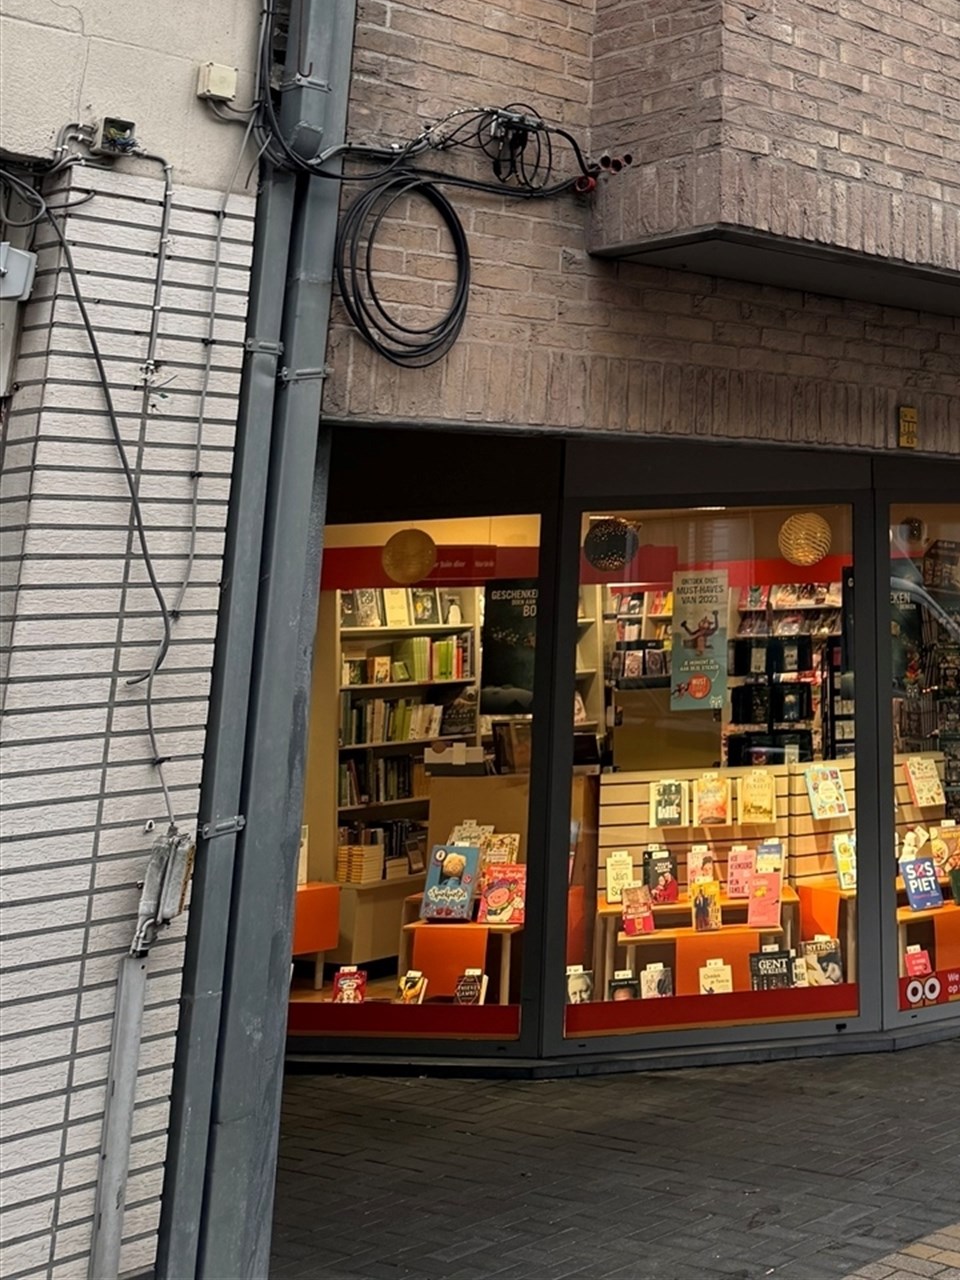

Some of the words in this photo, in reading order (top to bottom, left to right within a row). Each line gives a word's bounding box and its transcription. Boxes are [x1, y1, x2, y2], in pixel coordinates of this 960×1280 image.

[492, 588, 538, 600] GESCHENKE
[676, 585, 724, 595] MUST-HAVES
[681, 595, 697, 604] VAN
[698, 594, 718, 604] 2023
[909, 877, 936, 894] PIET
[758, 958, 788, 970] GENT
[947, 972, 960, 982] We
[948, 984, 958, 994] op
